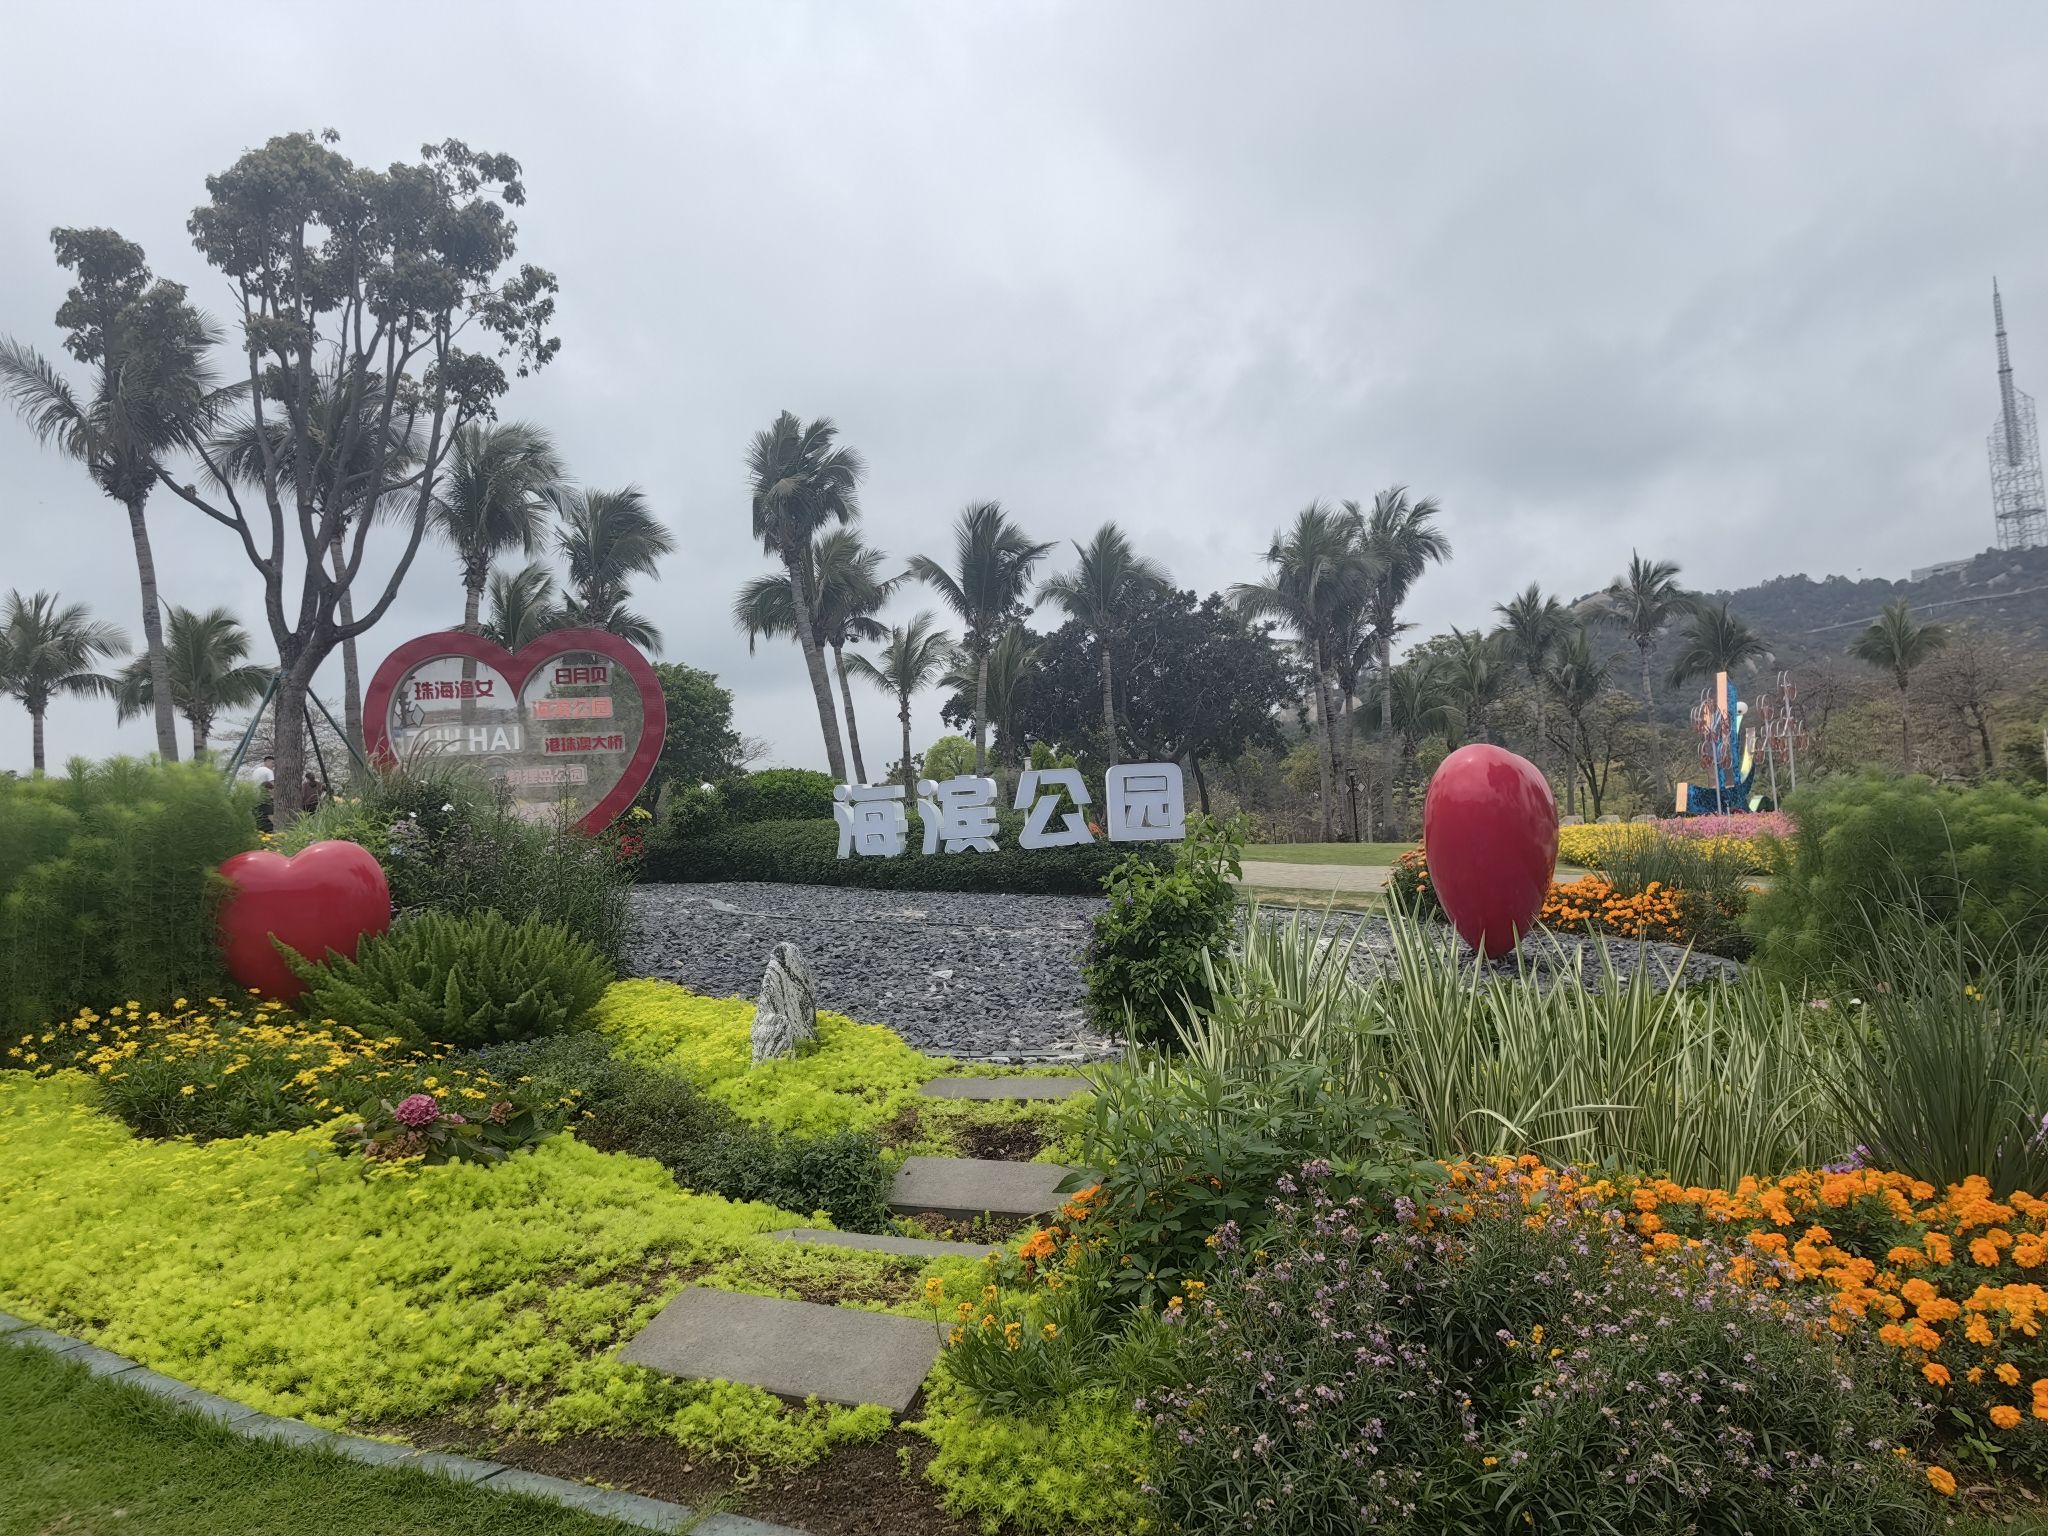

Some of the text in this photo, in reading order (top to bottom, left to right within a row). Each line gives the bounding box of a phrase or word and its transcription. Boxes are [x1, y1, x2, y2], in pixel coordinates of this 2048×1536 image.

[556, 666, 608, 684] 日月贝
[414, 679, 495, 701] 珠海渔女
[469, 726, 520, 752] HAI
[545, 735, 623, 753] 港珠澳大桥
[833, 763, 1186, 859] 海滨公园
